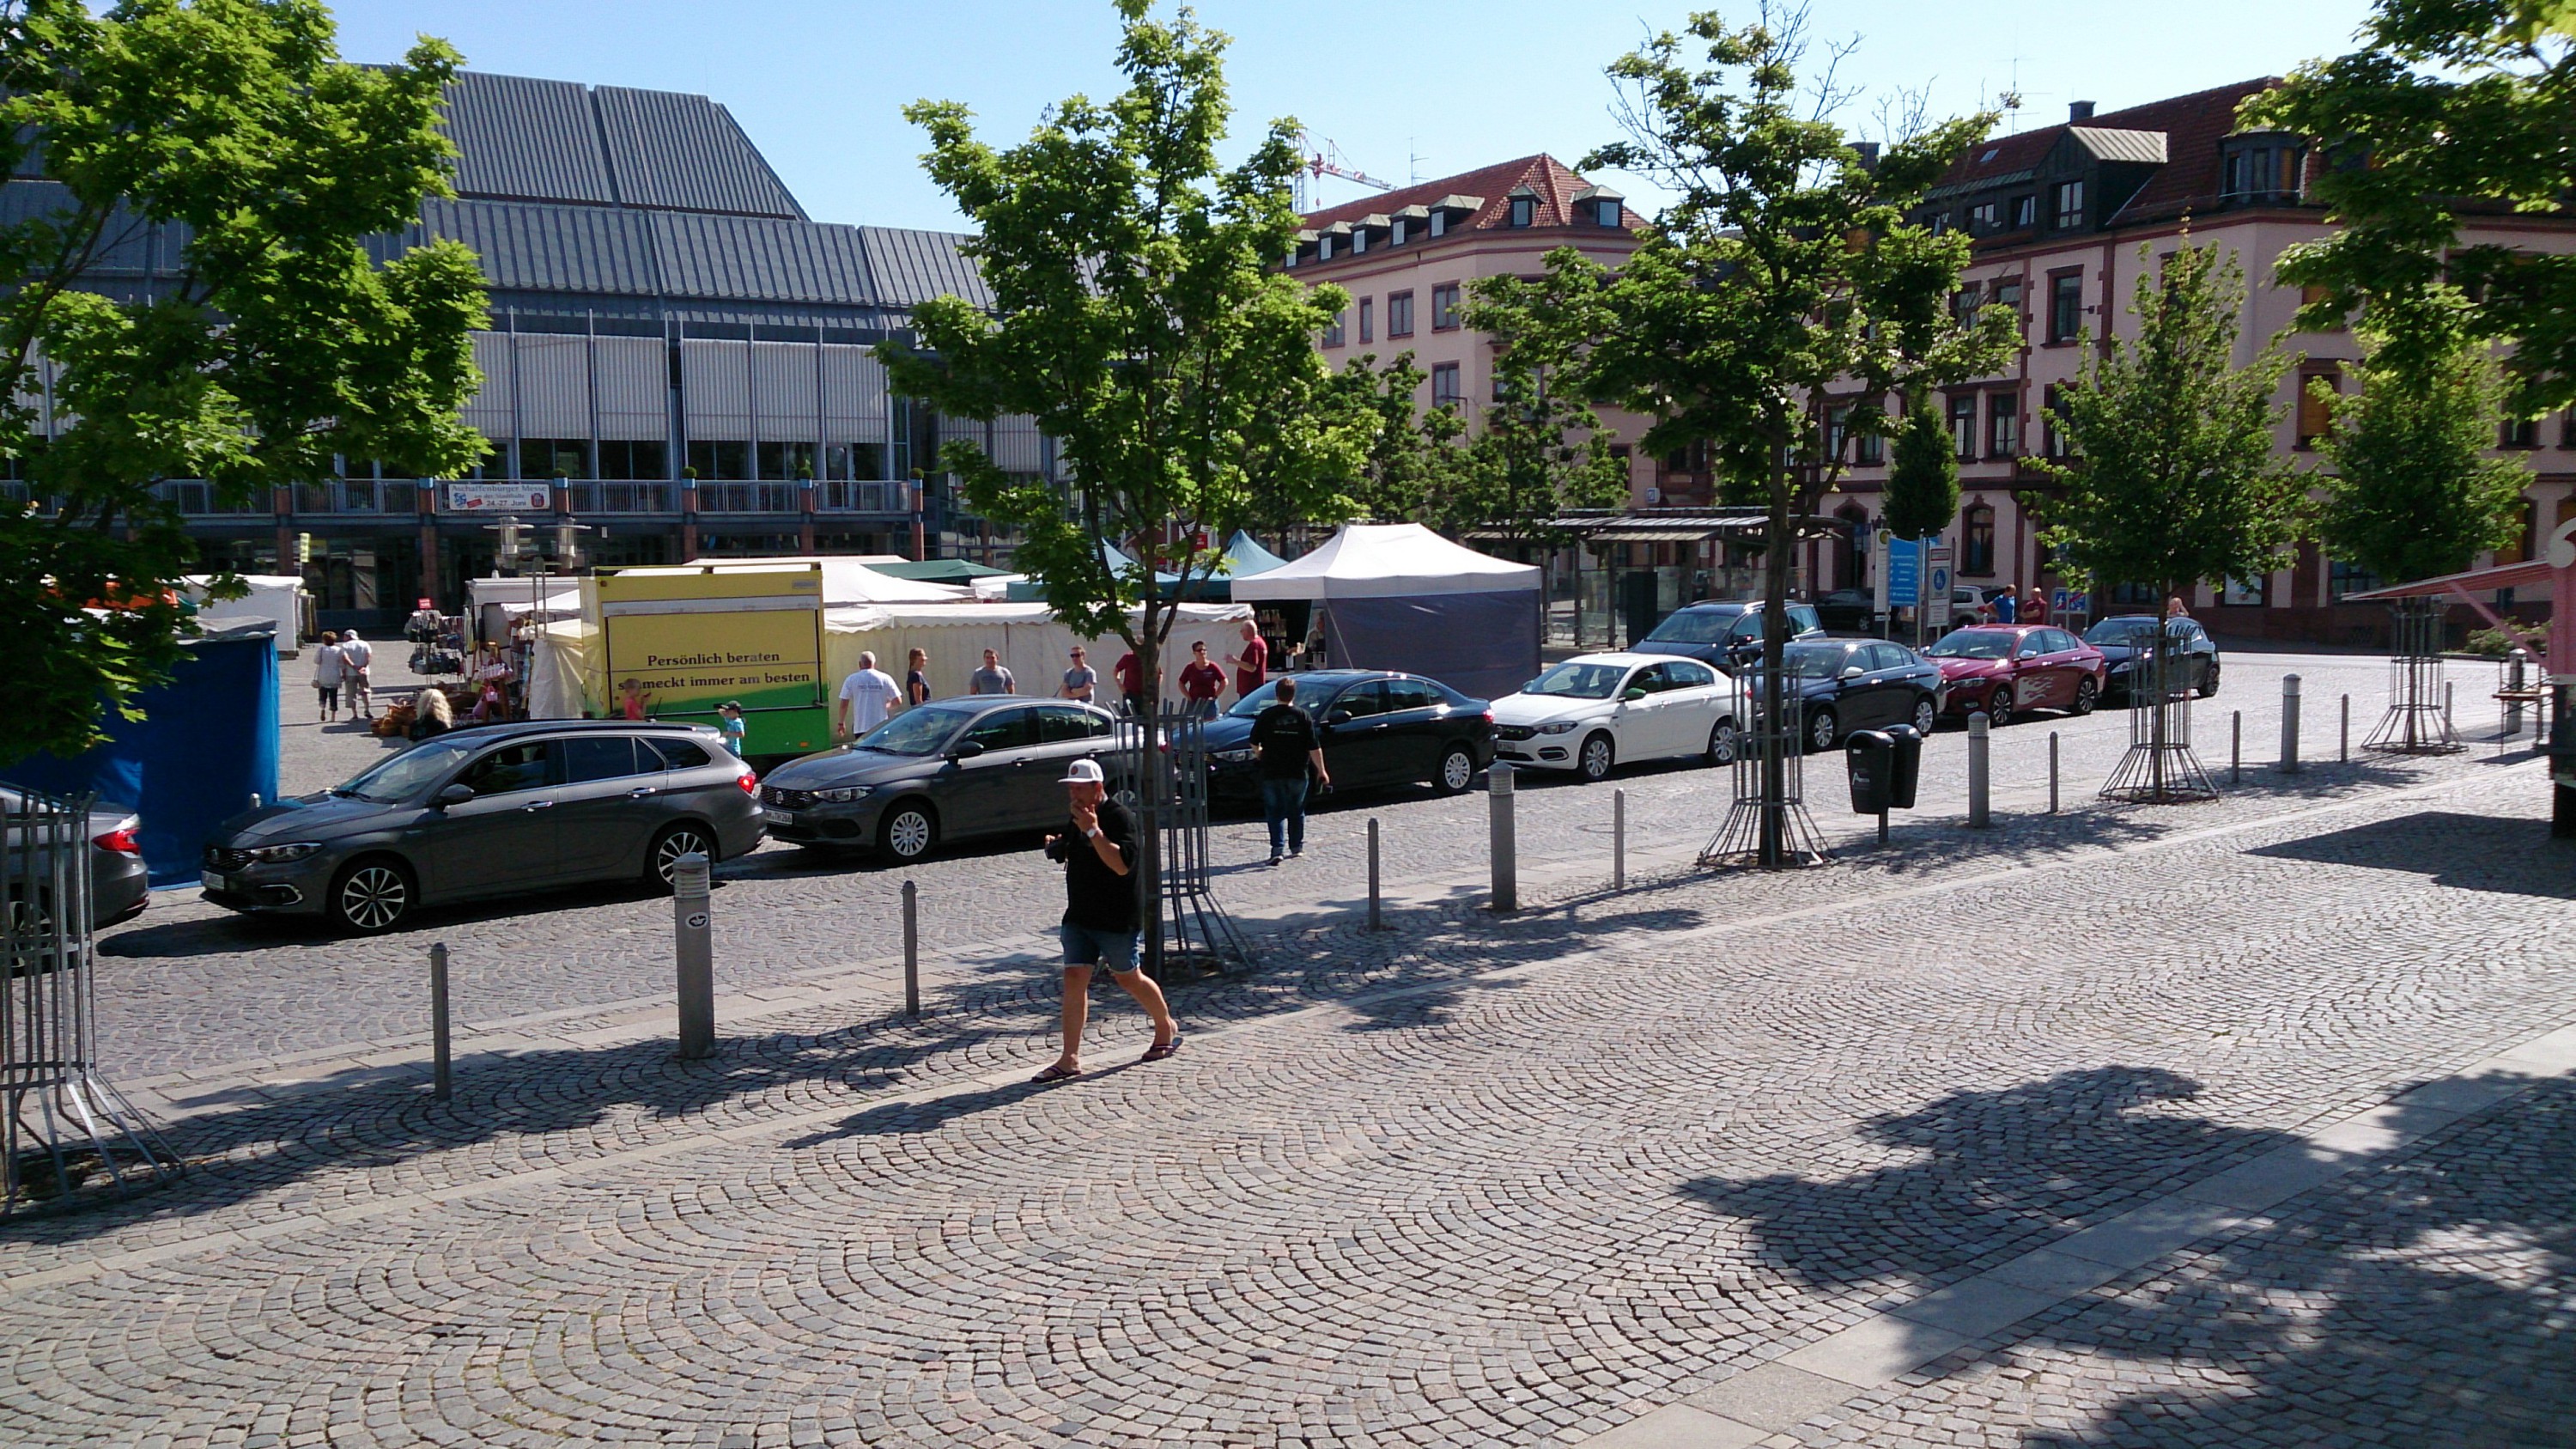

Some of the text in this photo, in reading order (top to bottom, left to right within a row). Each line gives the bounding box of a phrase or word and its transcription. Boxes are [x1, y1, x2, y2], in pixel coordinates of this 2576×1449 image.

[647, 652, 780, 667] Persönlich beraten
[617, 672, 810, 690] smeckt immer am besten
